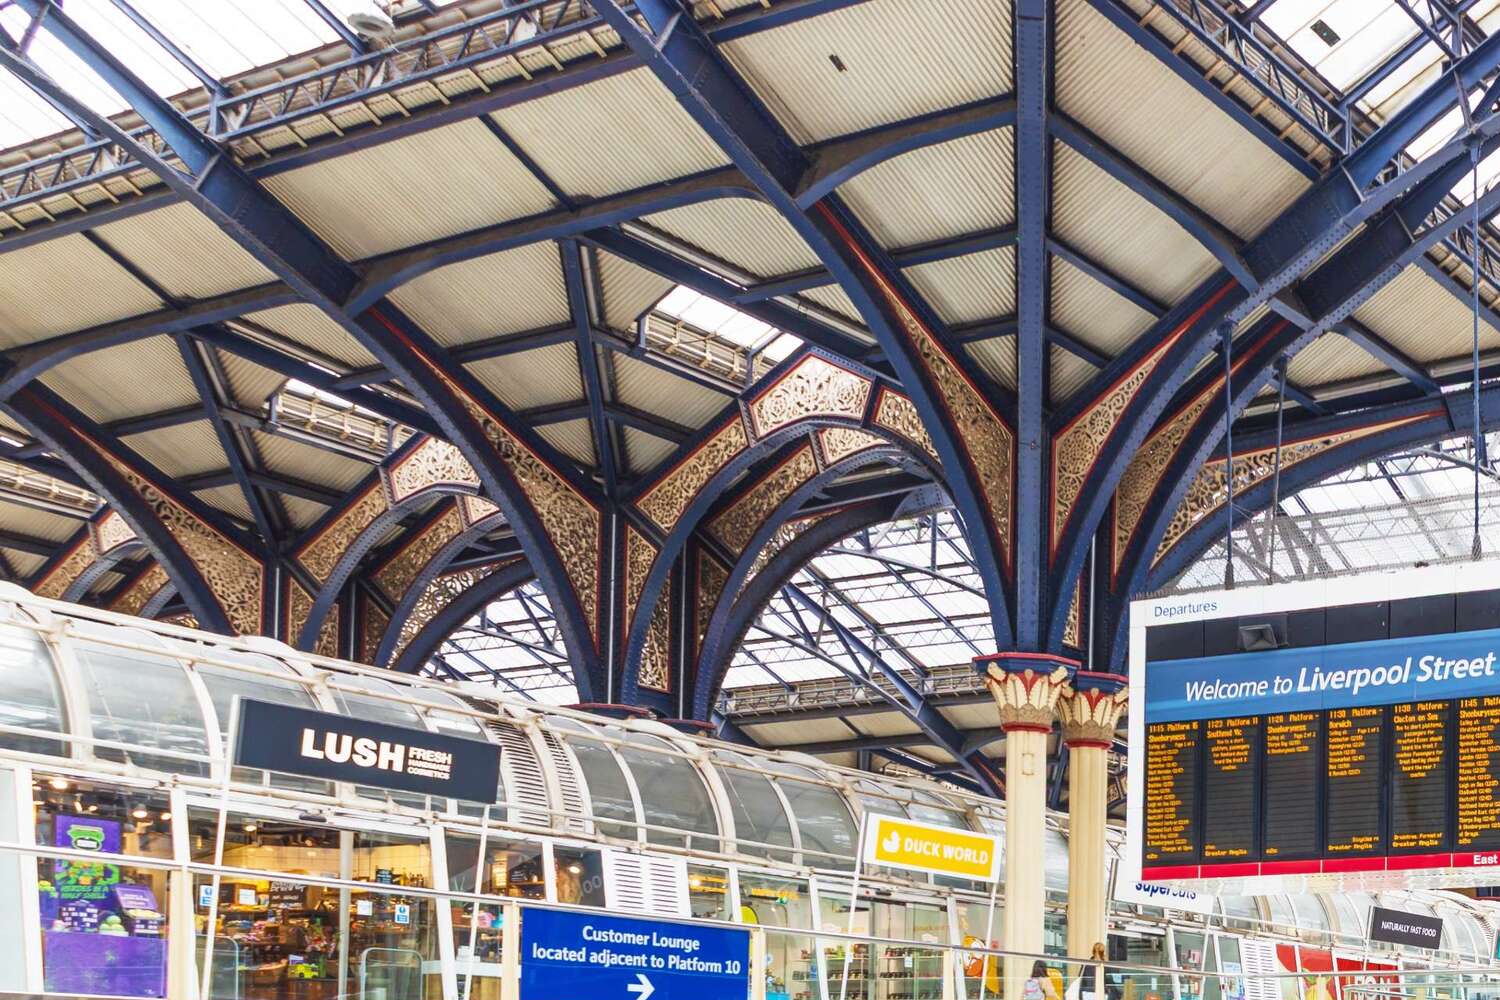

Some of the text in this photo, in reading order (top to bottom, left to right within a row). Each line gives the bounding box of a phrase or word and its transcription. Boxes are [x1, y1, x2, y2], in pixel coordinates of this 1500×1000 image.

[1153, 600, 1217, 618] Departures
[1185, 680, 1268, 701] Welcome
[1273, 678, 1293, 695] to
[1296, 656, 1412, 694] Liverpool
[1415, 651, 1495, 682] Street
[301, 728, 405, 772] LUSH
[409, 747, 452, 764] FRESH
[904, 838, 988, 864] DUCK WORLD
[1473, 855, 1498, 865] East
[582, 925, 700, 952] Customer Lounge
[1381, 921, 1436, 937] NATURALLY FAST FOOD
[532, 943, 740, 975] located adjacent to Platform 10
